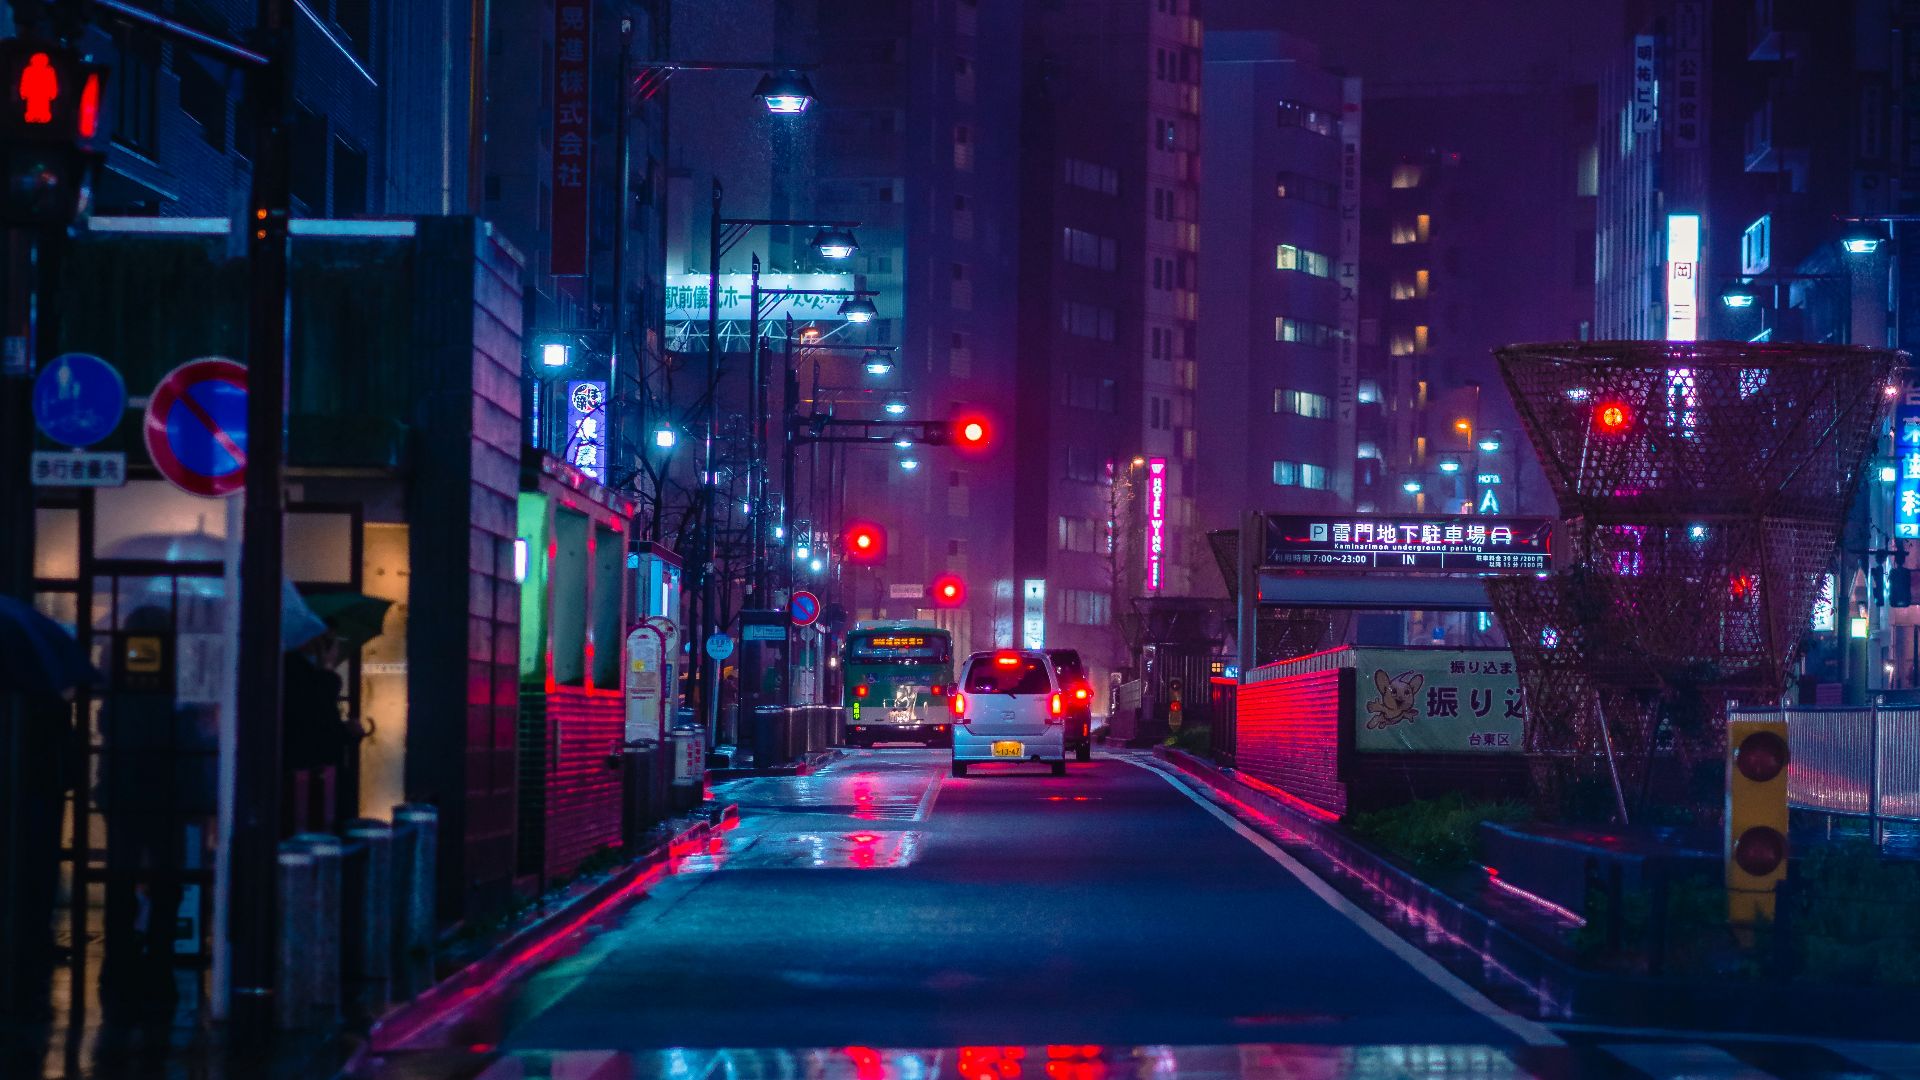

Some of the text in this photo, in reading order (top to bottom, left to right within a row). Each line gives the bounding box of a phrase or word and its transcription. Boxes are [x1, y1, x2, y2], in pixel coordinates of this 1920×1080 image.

[37, 460, 118, 479] 歩行者優先
[1152, 477, 1163, 518] HOTEL
[1332, 523, 1486, 545] 雷門地下駐車場
[1334, 543, 1482, 553] Kaminarimon underground parking
[1402, 554, 1416, 565] IN
[1449, 660, 1519, 675] 振り込ま
[1468, 733, 1511, 747] 台東区
